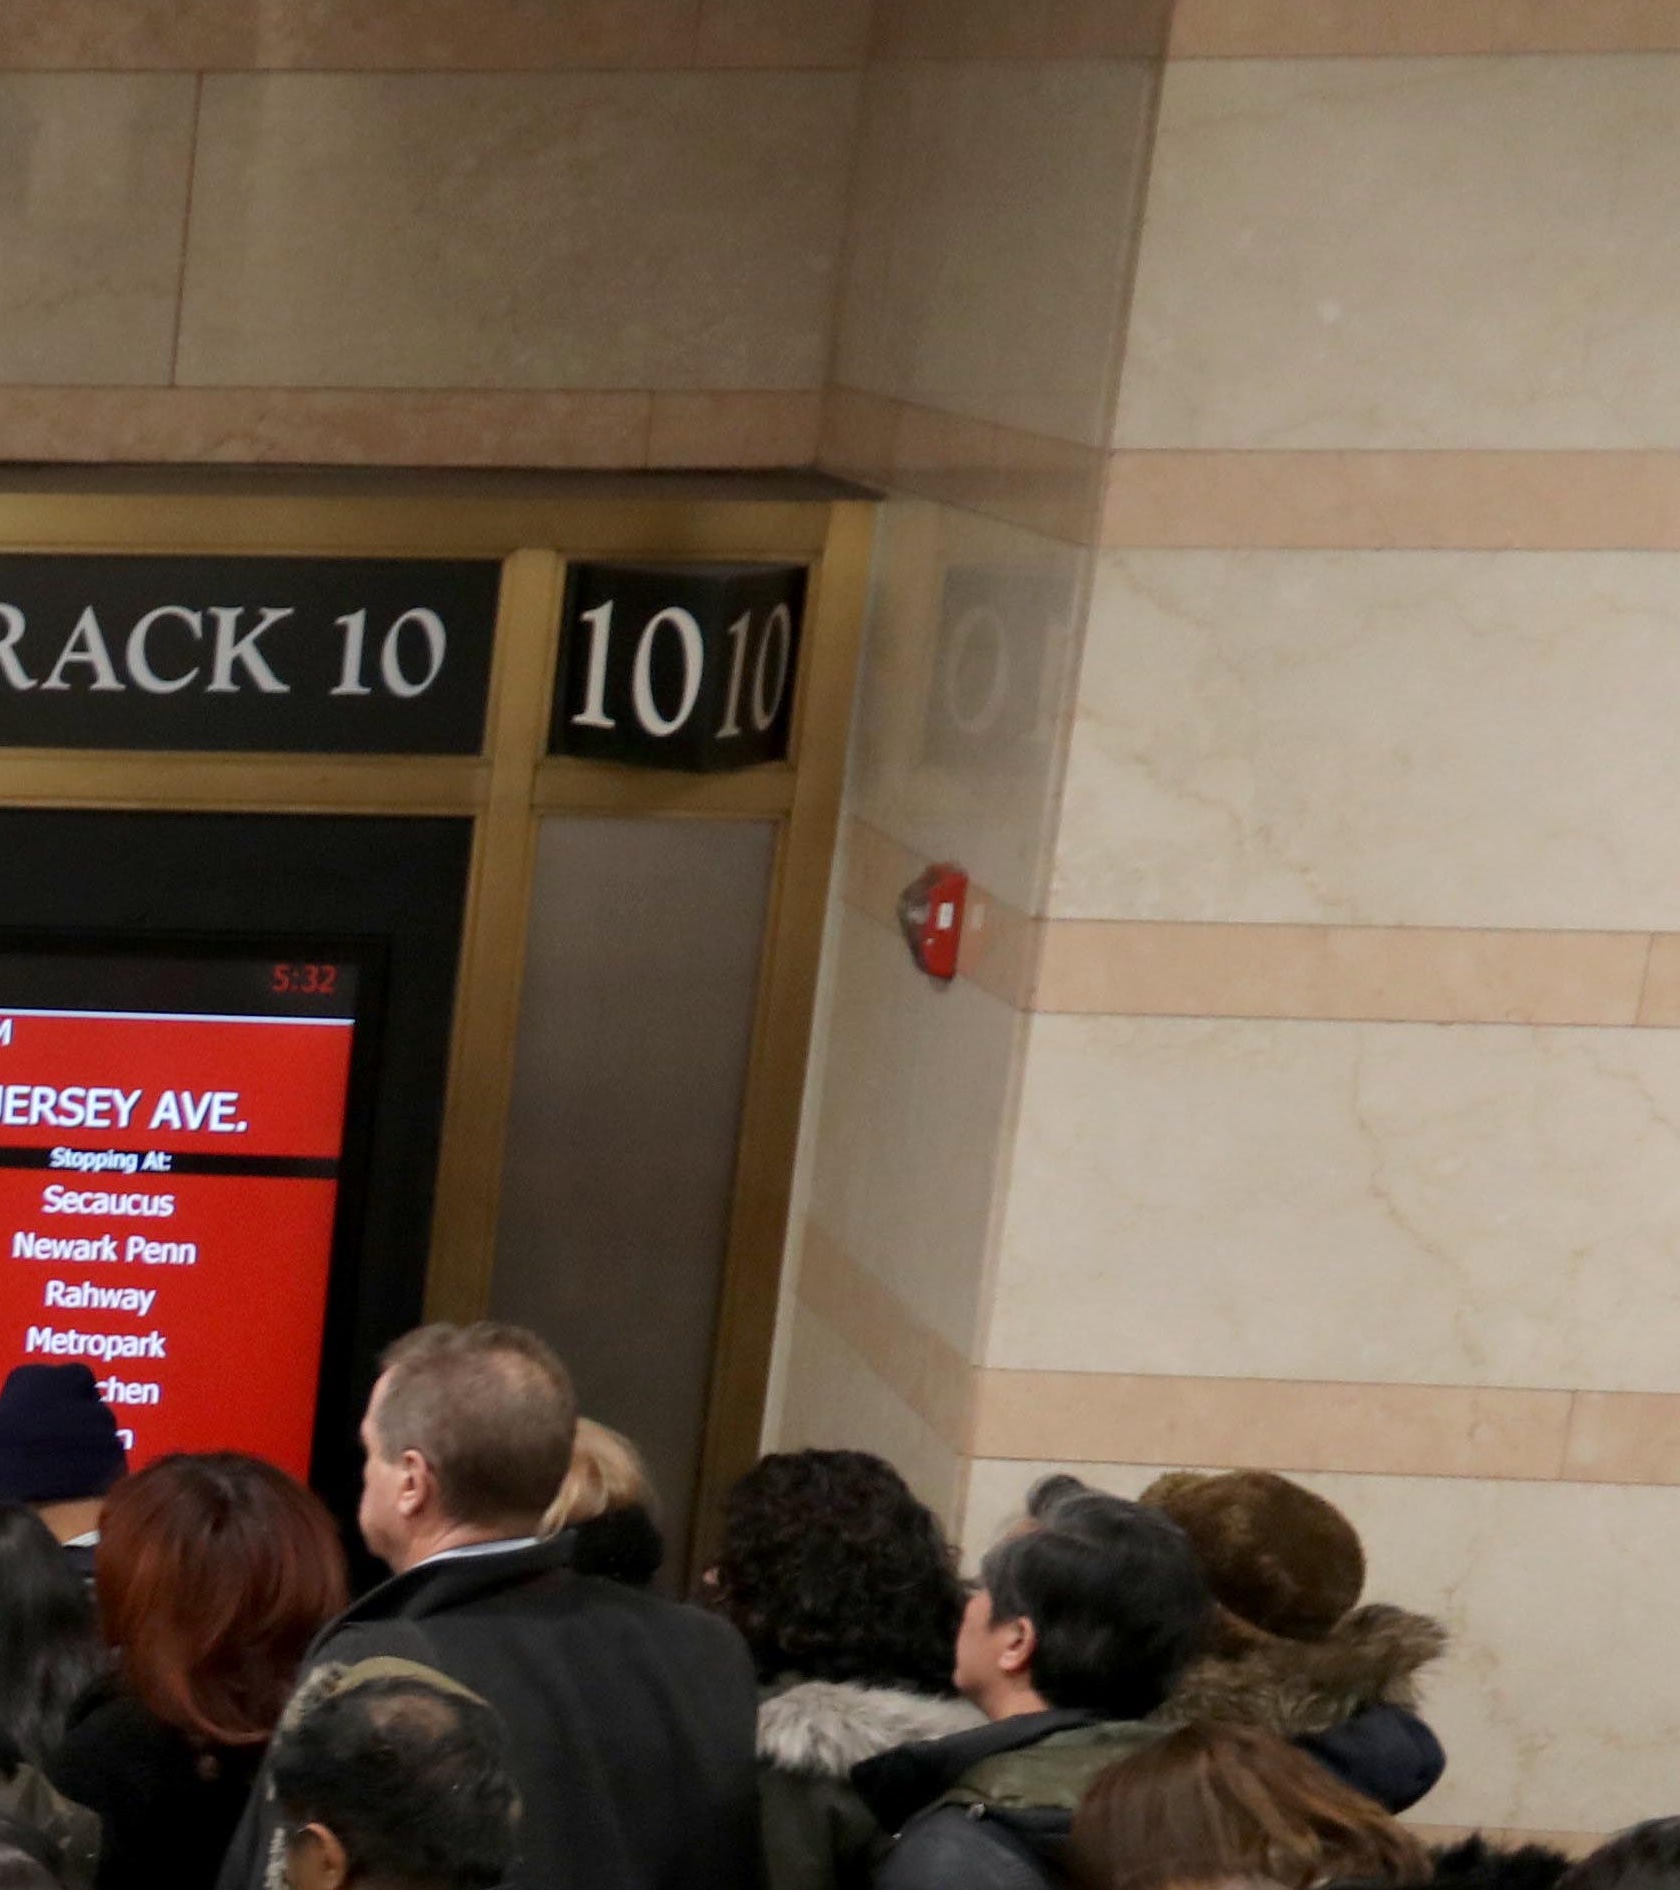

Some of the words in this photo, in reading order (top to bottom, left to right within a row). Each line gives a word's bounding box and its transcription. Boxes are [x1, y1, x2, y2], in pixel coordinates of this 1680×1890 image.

[330, 605, 447, 699] 10
[571, 598, 704, 739] 10
[715, 601, 791, 741] 10
[272, 964, 337, 993] 5:32
[149, 1091, 248, 1133] AVE.
[50, 1146, 138, 1174] Stopping
[142, 1149, 172, 1173] At:
[42, 1184, 175, 1218] Secaucus
[12, 1231, 118, 1264] Newark
[125, 1235, 197, 1265] Penn
[44, 1279, 156, 1317] Rahway
[25, 1326, 166, 1362] Metropark
